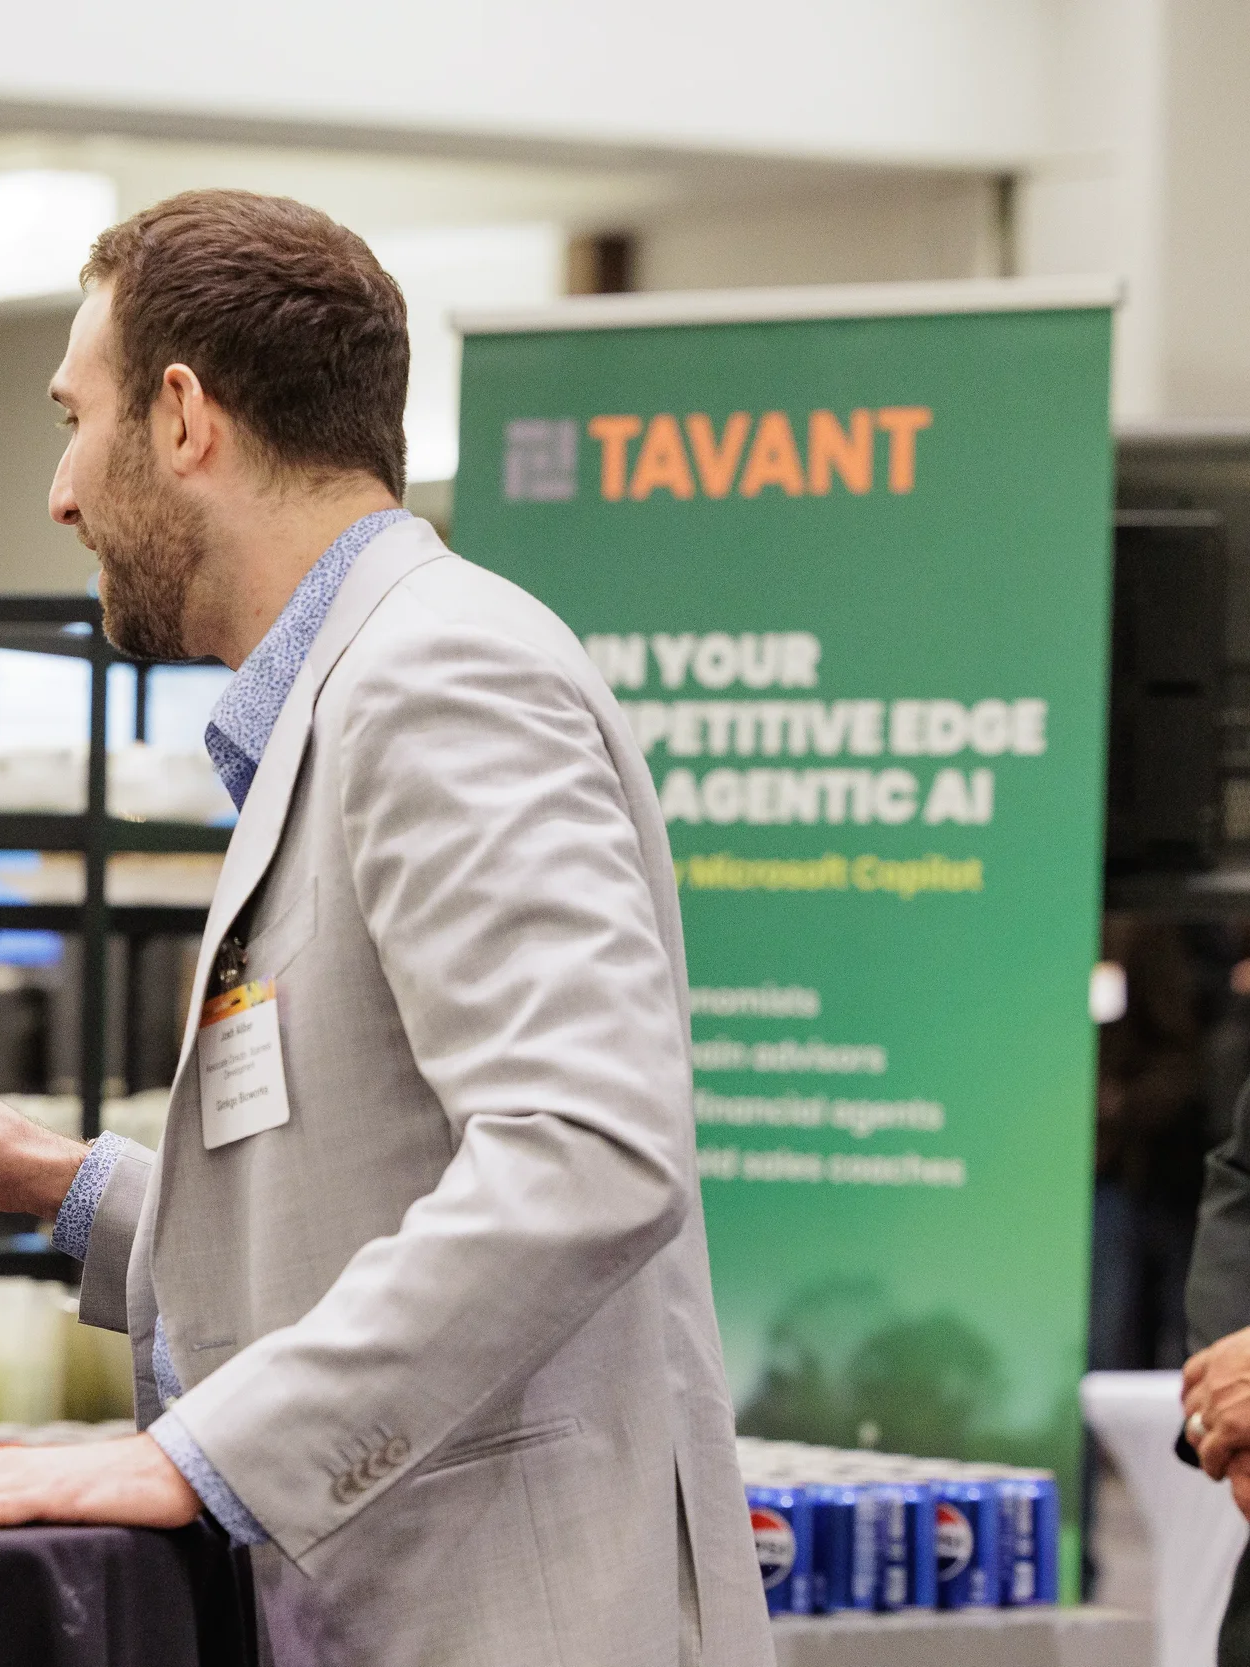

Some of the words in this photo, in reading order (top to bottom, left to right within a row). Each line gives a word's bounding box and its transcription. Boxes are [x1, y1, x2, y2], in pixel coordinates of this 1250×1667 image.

[588, 405, 933, 501] TAVANT
[582, 632, 647, 690] IN
[651, 630, 821, 690] YOUR
[621, 699, 886, 758] PETITIVE
[888, 698, 1047, 757] EDGE
[659, 768, 919, 826] AGENTIC
[921, 768, 996, 826] AI
[689, 852, 848, 892] Microsoft
[850, 852, 984, 900] Copilot
[689, 979, 821, 1019] nomists
[691, 1034, 747, 1072] ain
[751, 1036, 888, 1075] advisors
[831, 1097, 946, 1138] agents
[741, 1145, 824, 1183] sales
[826, 1150, 968, 1188] coaches
